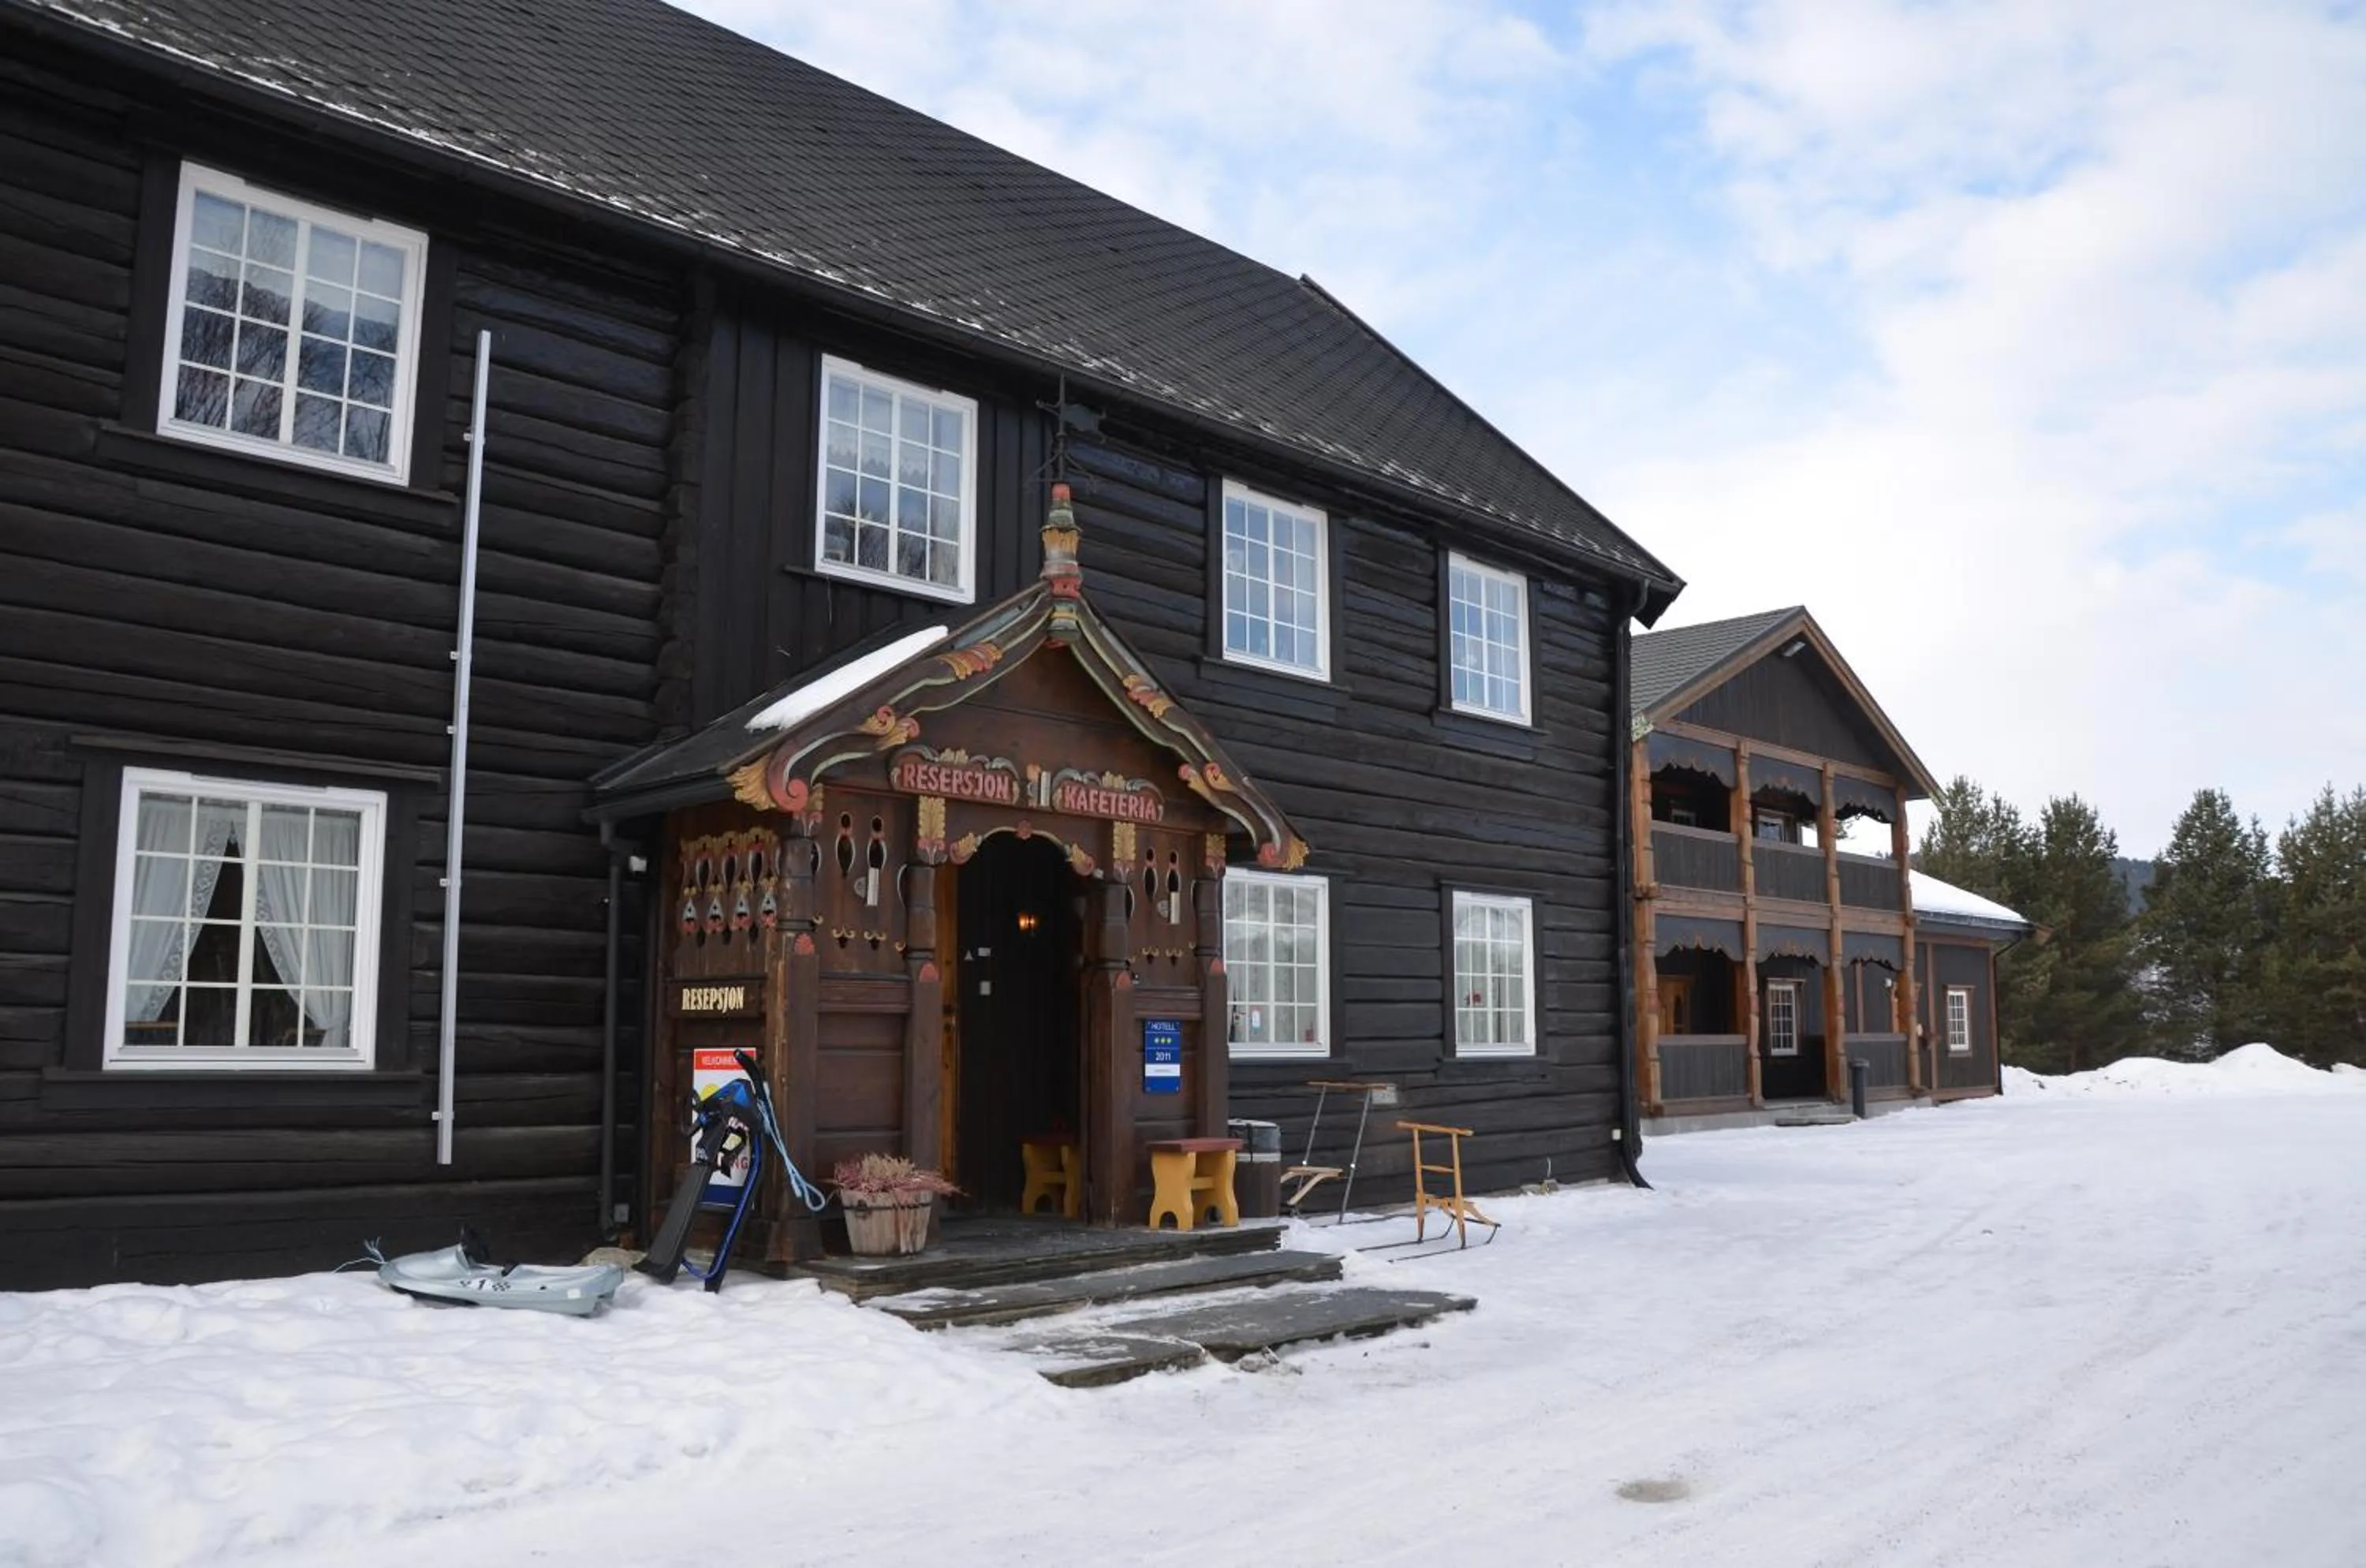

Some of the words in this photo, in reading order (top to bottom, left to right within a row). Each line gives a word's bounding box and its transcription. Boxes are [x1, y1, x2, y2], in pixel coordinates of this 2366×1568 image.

[903, 763, 1009, 800] RESEPSJON
[1065, 784, 1157, 821] KAFETERIA
[681, 986, 745, 1013] RESEPSJON
